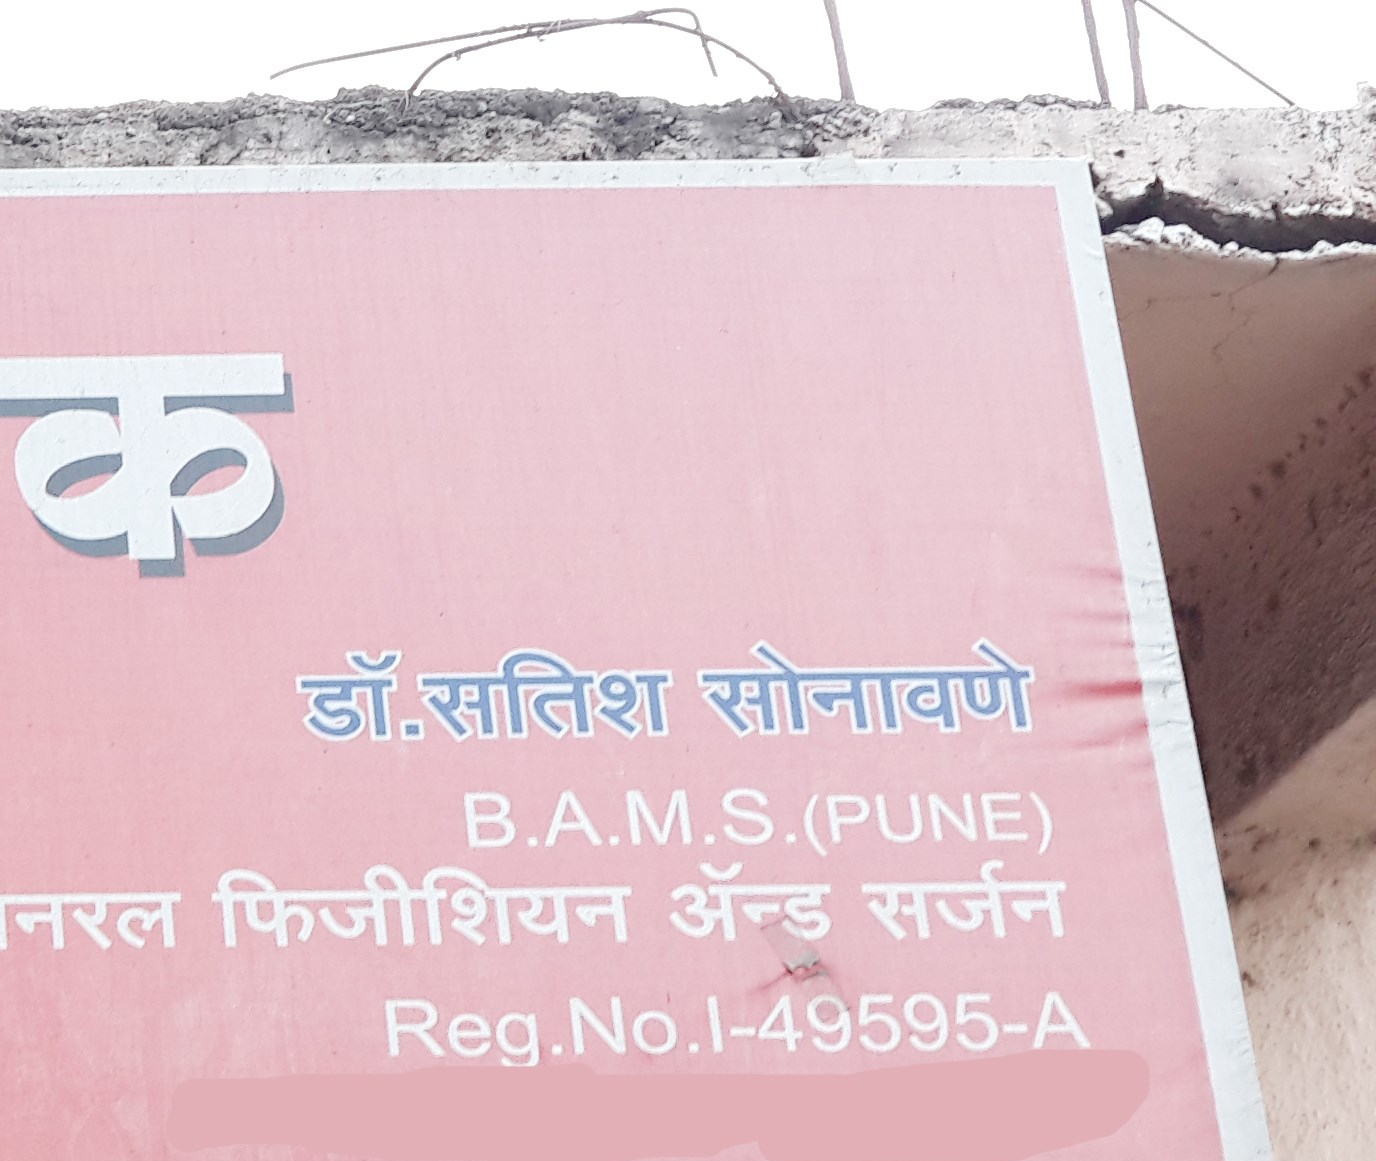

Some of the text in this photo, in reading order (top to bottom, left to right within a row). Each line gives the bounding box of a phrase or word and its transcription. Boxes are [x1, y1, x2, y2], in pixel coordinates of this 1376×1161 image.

[698, 638, 1036, 739] सोनावणे
[211, 865, 631, 949] फिजीशियन
[860, 860, 1067, 940] सर्जन
